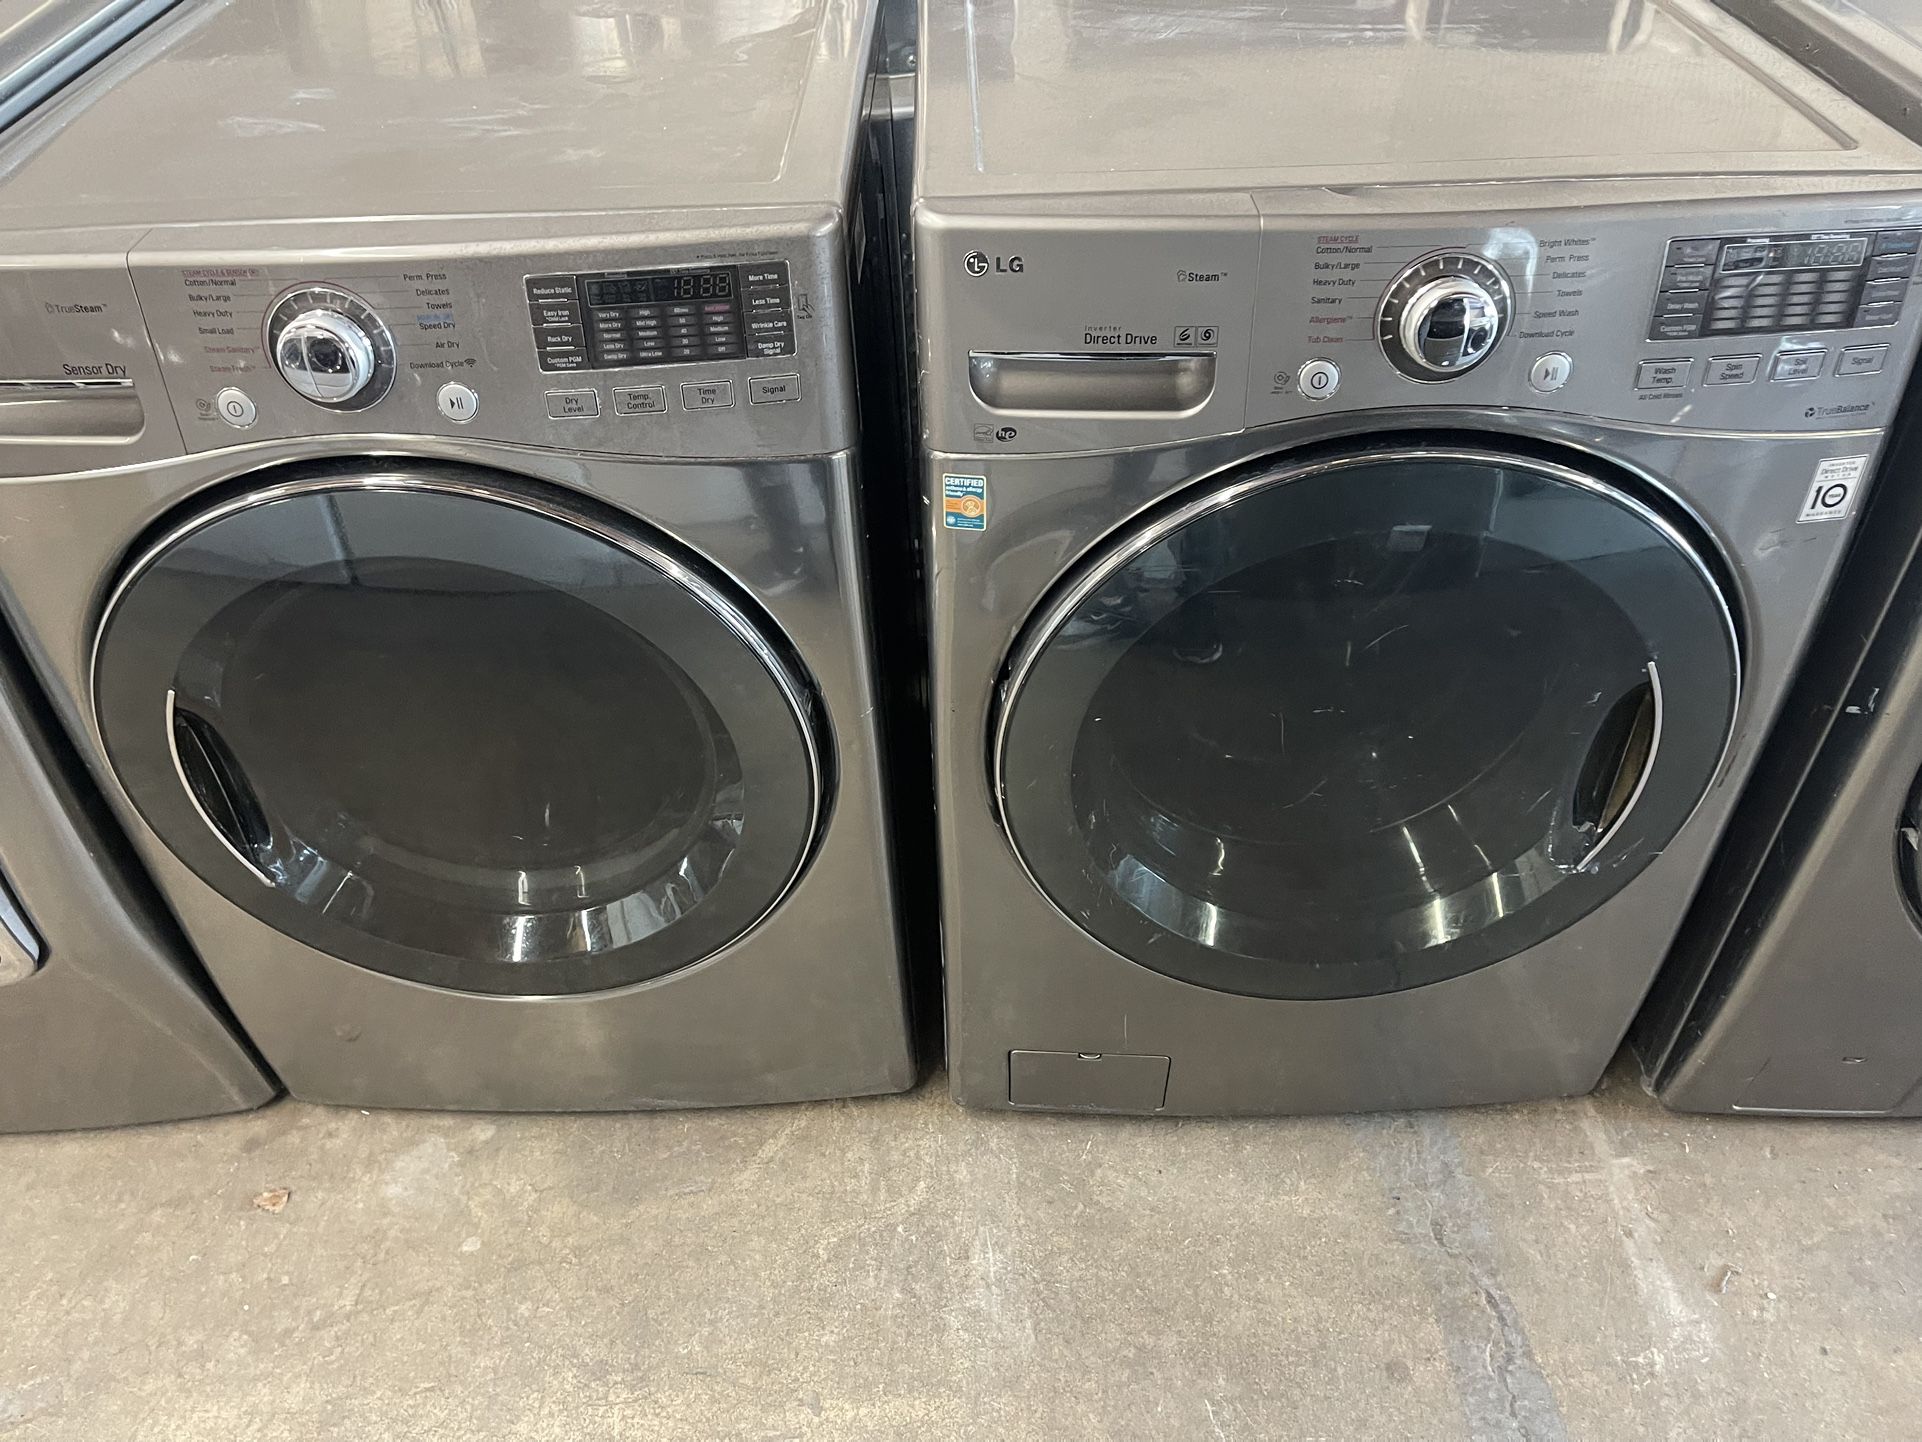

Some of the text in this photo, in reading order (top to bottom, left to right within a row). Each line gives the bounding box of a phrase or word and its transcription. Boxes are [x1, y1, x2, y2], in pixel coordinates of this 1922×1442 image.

[1540, 240, 1562, 248] Bright
[1316, 245, 1373, 254] Cotton/Normal
[995, 255, 1024, 273] LG
[1314, 261, 1361, 271] Bulky/Large
[1552, 271, 1586, 279] Delicates
[1312, 278, 1357, 287] Heavy Duty
[415, 288, 450, 297] Delicates
[188, 294, 231, 302] Bulky/Large
[1311, 296, 1343, 305] Sanitary
[426, 302, 453, 310] Towels
[193, 309, 232, 318] Heavy Duty
[1534, 311, 1557, 319] Speed
[419, 321, 456, 331] Speed Dry
[751, 321, 773, 329] Wrinkle
[1555, 330, 1575, 338] Cycle
[1084, 333, 1158, 345] Direct Drive
[447, 340, 460, 349] Dry
[614, 342, 624, 350] Dry
[763, 347, 781, 355] Signal
[410, 360, 465, 369] Download Cycle
[1851, 357, 1874, 365] Signal
[62, 362, 126, 376] Sensor Dry
[1726, 363, 1743, 371] Spin
[1720, 372, 1744, 380] Speed
[697, 388, 717, 396] Time
[761, 385, 786, 395] Signal
[564, 396, 579, 405] Dry
[701, 396, 715, 405] Dry
[562, 406, 585, 414] Level
[626, 401, 656, 410] Control
[945, 478, 984, 487] CERTIFIED
[1811, 483, 1847, 510] 10
